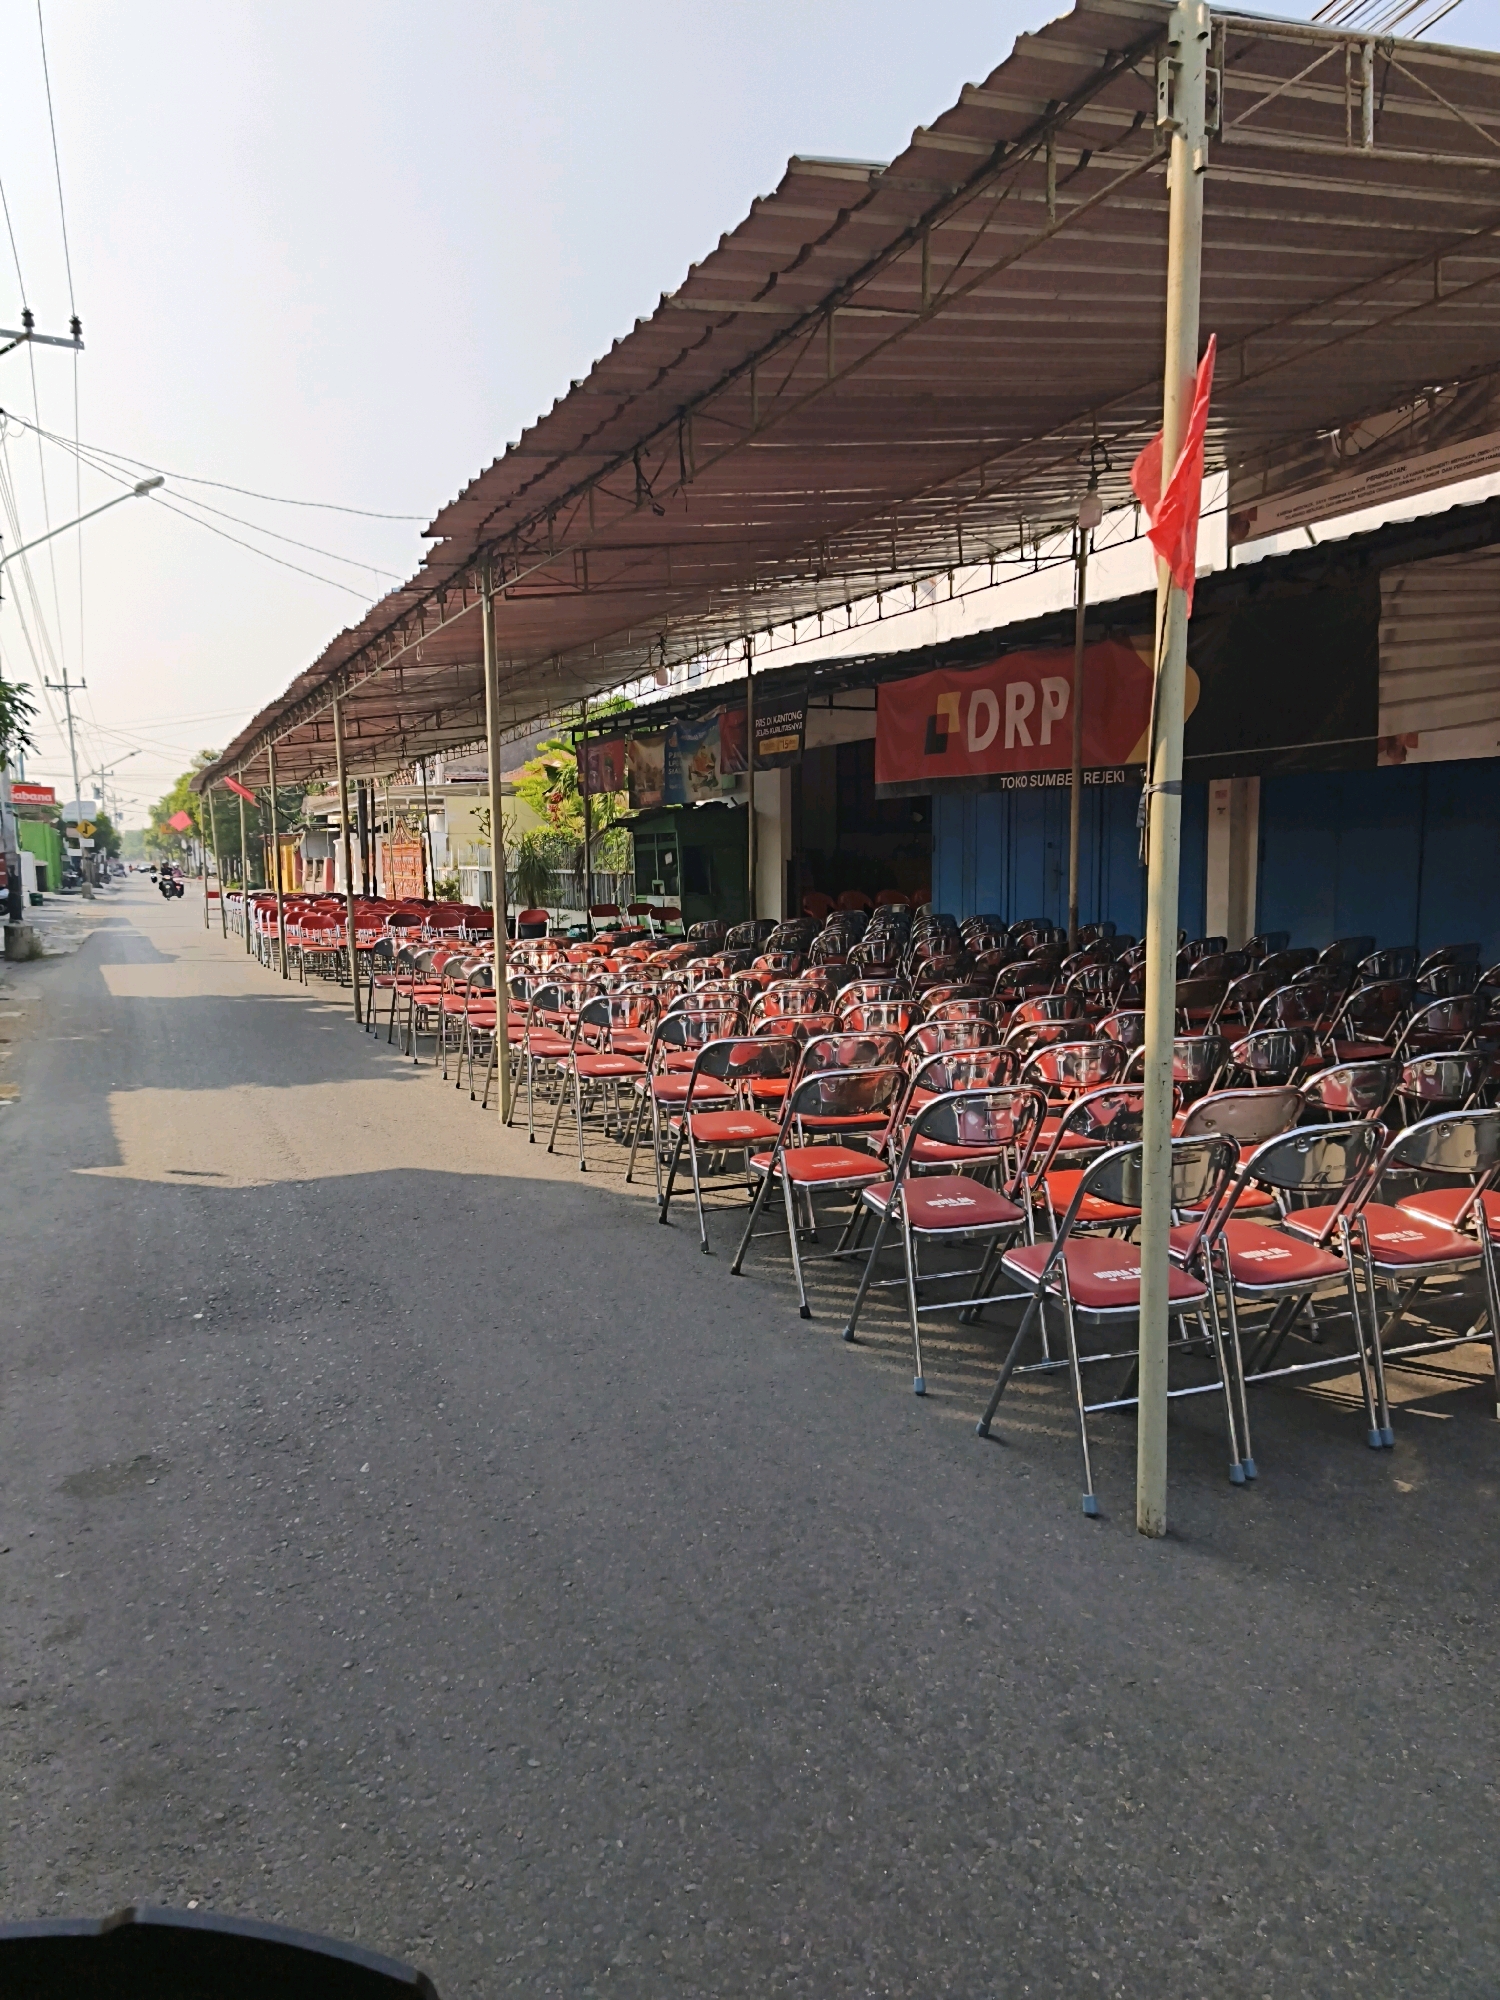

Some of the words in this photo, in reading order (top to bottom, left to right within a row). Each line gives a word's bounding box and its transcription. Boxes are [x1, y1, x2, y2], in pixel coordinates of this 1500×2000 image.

[967, 676, 1070, 753] DRP
[1000, 776, 1028, 789] TOKO
[1029, 773, 1073, 787] SUMBE
[1083, 770, 1125, 784] REJEKI
